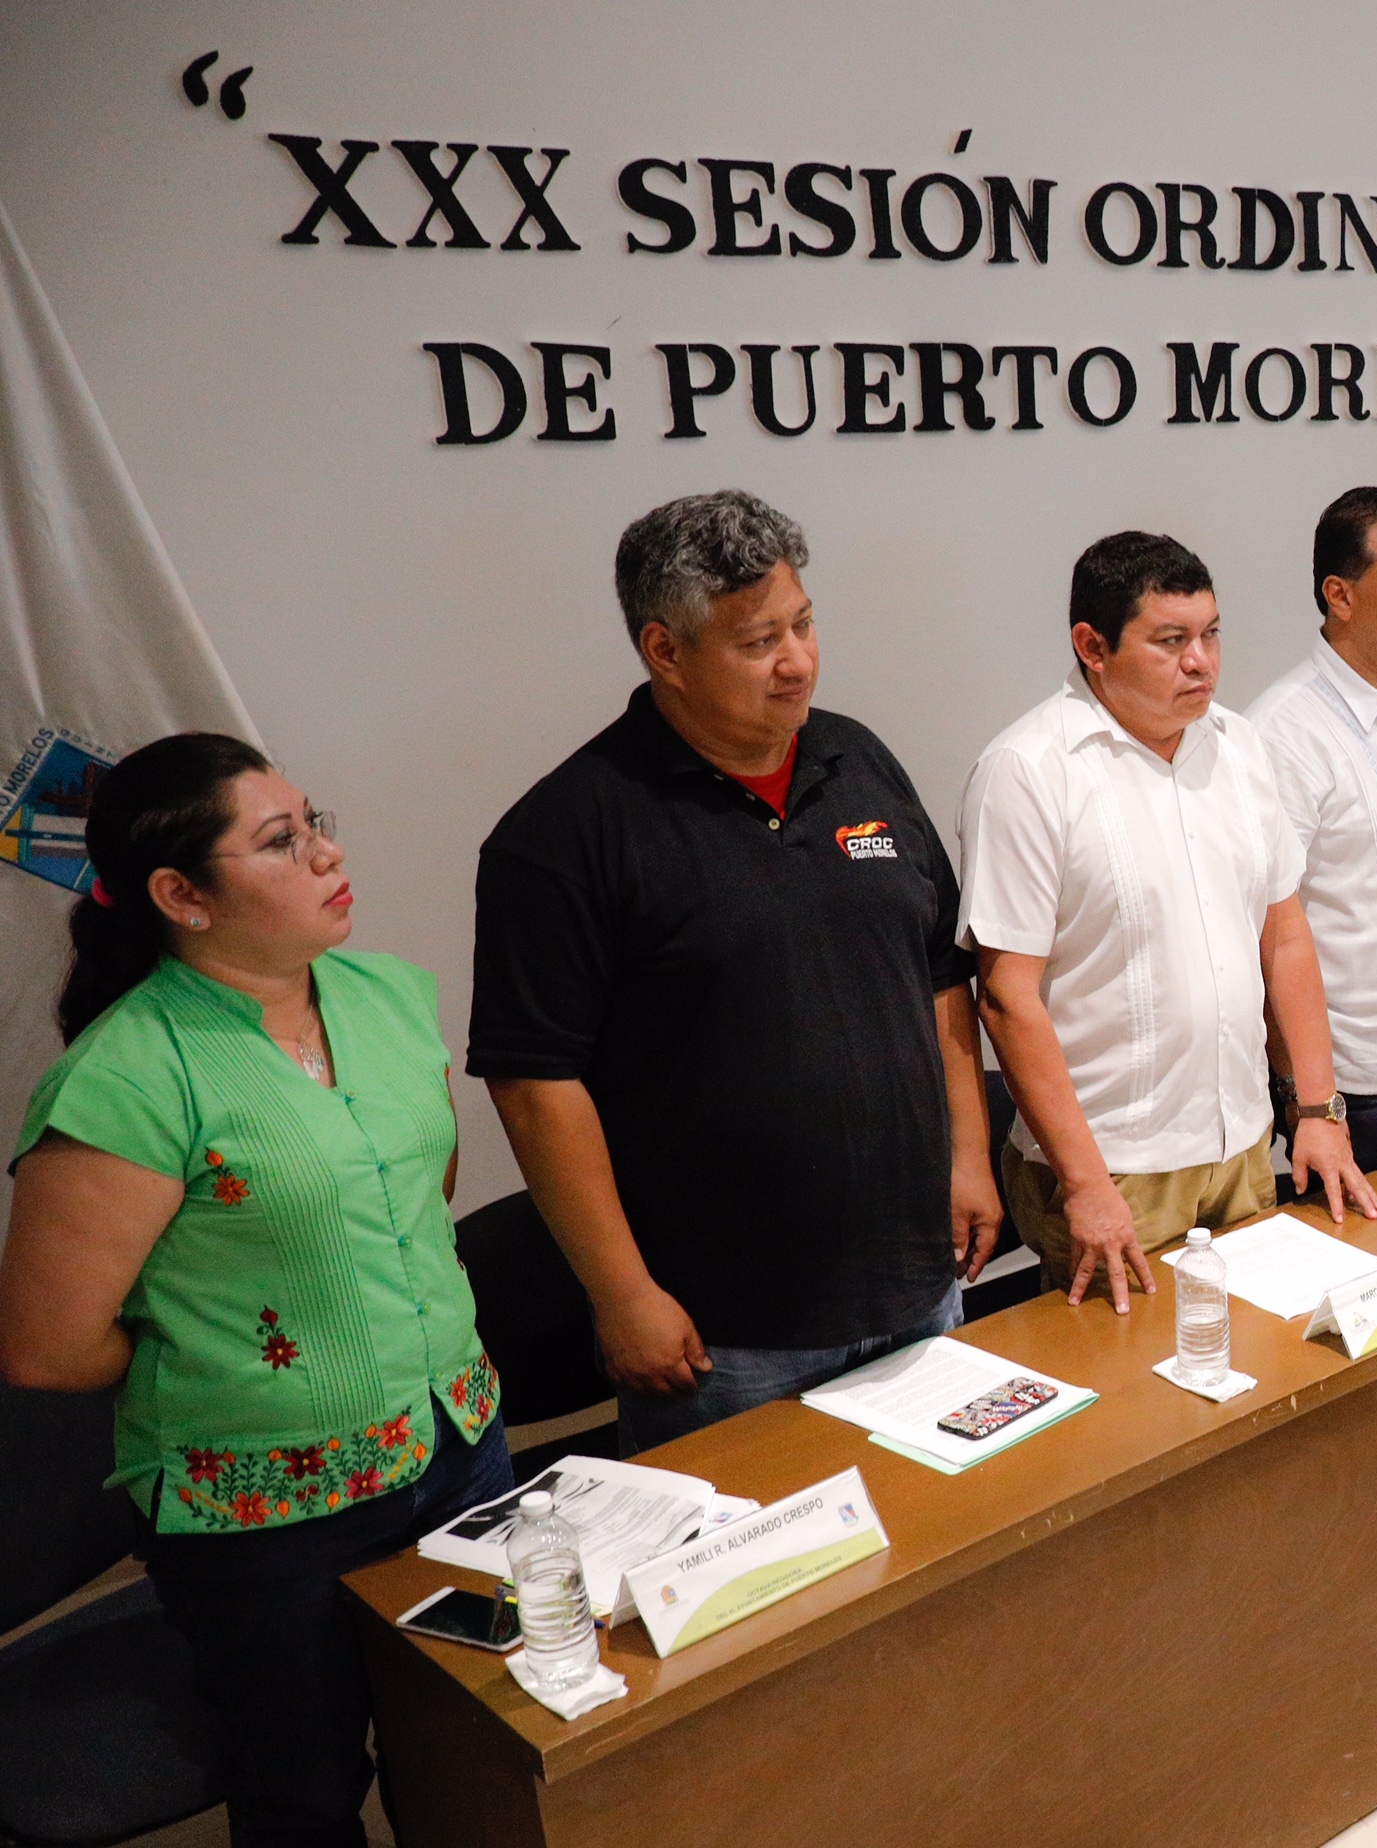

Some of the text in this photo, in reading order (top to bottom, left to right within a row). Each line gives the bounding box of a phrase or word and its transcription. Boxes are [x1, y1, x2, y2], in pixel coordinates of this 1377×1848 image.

[267, 132, 582, 254] XXX
[615, 129, 1058, 265] SESIÓN
[422, 341, 617, 446] DE
[654, 342, 1137, 440] PUERTO
[3, 728, 54, 794] MORELOS
[847, 837, 893, 851] CROC
[677, 1496, 825, 1574] YAMILI R. ALVARADO CRESPO
[814, 1555, 843, 1574] MORELOS
[746, 1566, 803, 1599] OCTAVA REGIDORA
